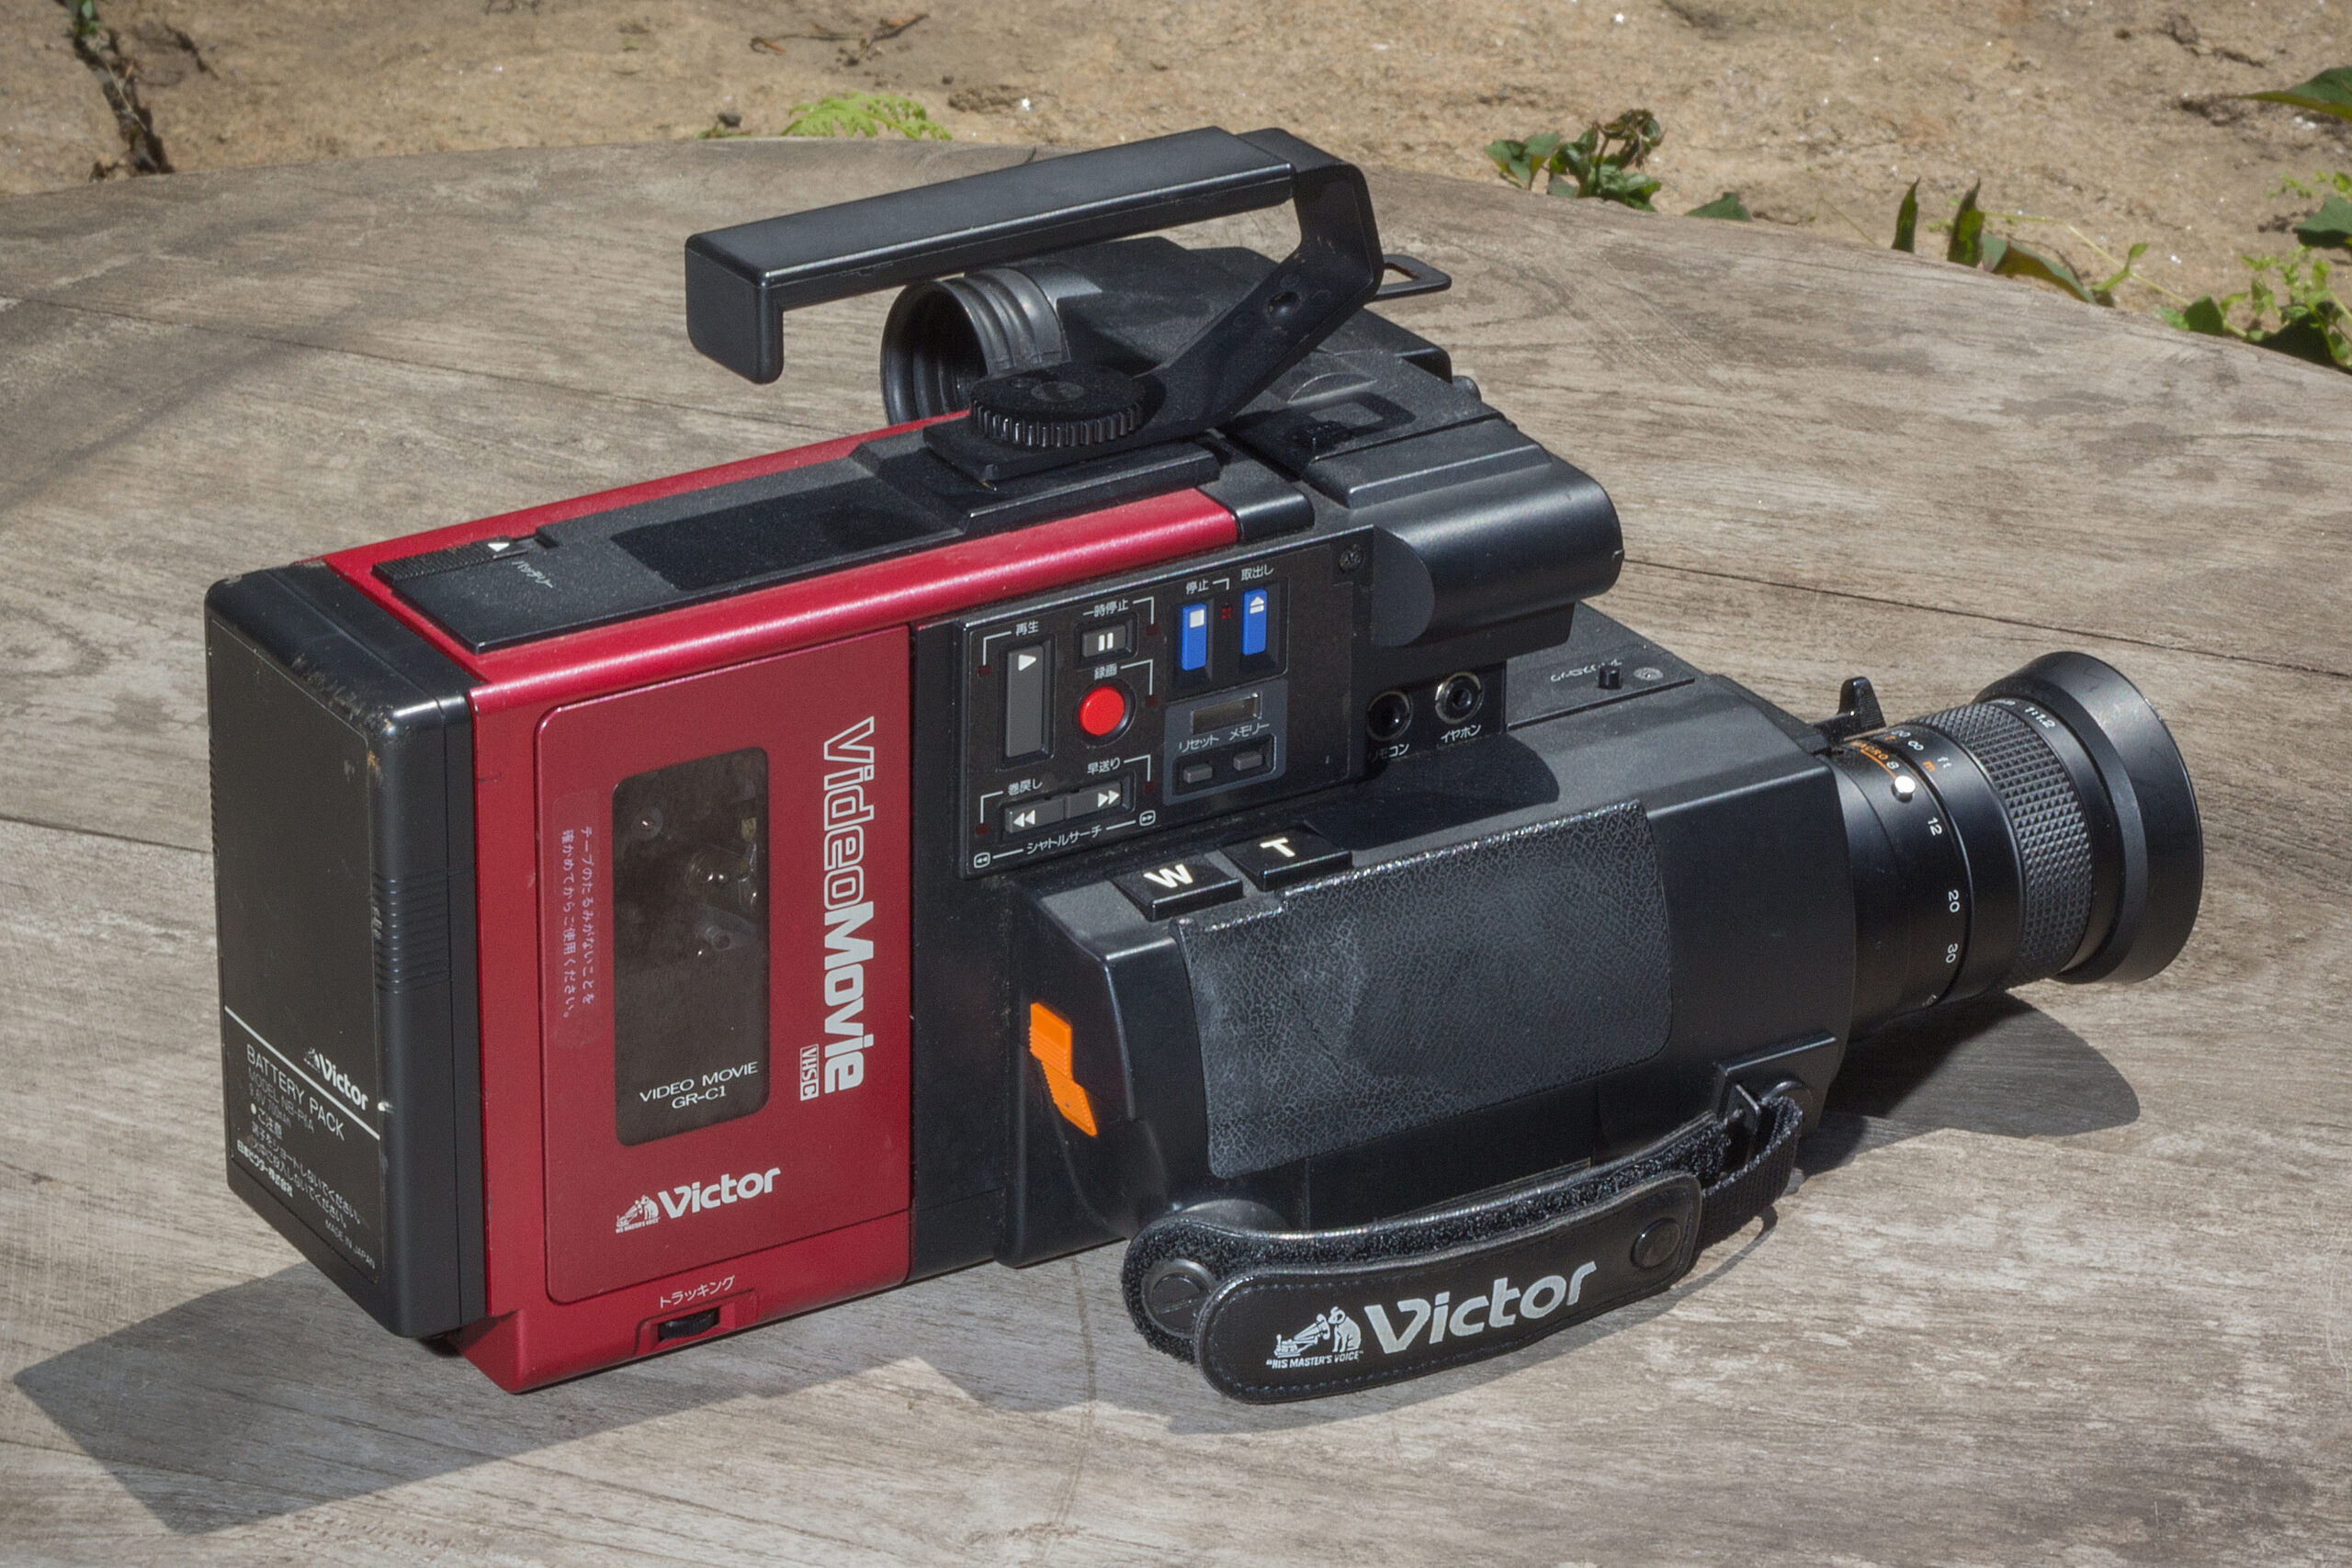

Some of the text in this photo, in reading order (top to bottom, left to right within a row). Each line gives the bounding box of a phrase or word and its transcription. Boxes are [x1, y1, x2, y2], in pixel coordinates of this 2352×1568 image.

[1241, 564, 1274, 581] 取出し
[1185, 579, 1209, 595] 停止
[1082, 599, 1128, 617] 一時停止
[1015, 621, 1039, 636] 再生
[1179, 723, 1270, 752] リセット メモリー
[1441, 725, 1481, 742] イヤホン
[1087, 757, 1121, 774] 早送り
[1008, 779, 1043, 795] 巻戻し
[1928, 817, 1942, 836] 12
[1026, 825, 1102, 854] シャトルサーチ
[1259, 837, 1295, 858] T
[1143, 863, 1193, 888] W
[1948, 889, 1960, 913] 20
[581, 826, 595, 1005] テープのたるみがないことを
[1945, 942, 1958, 964] 30
[246, 1043, 345, 1142] BATTERY PACK
[319, 1053, 368, 1111] Victor
[639, 1061, 759, 1103] VIDEO MOVIE
[671, 1085, 728, 1110] GR-C1
[658, 1167, 782, 1220] Victor
[660, 1275, 736, 1308] トラッキング
[1363, 1260, 1598, 1355] Victor
